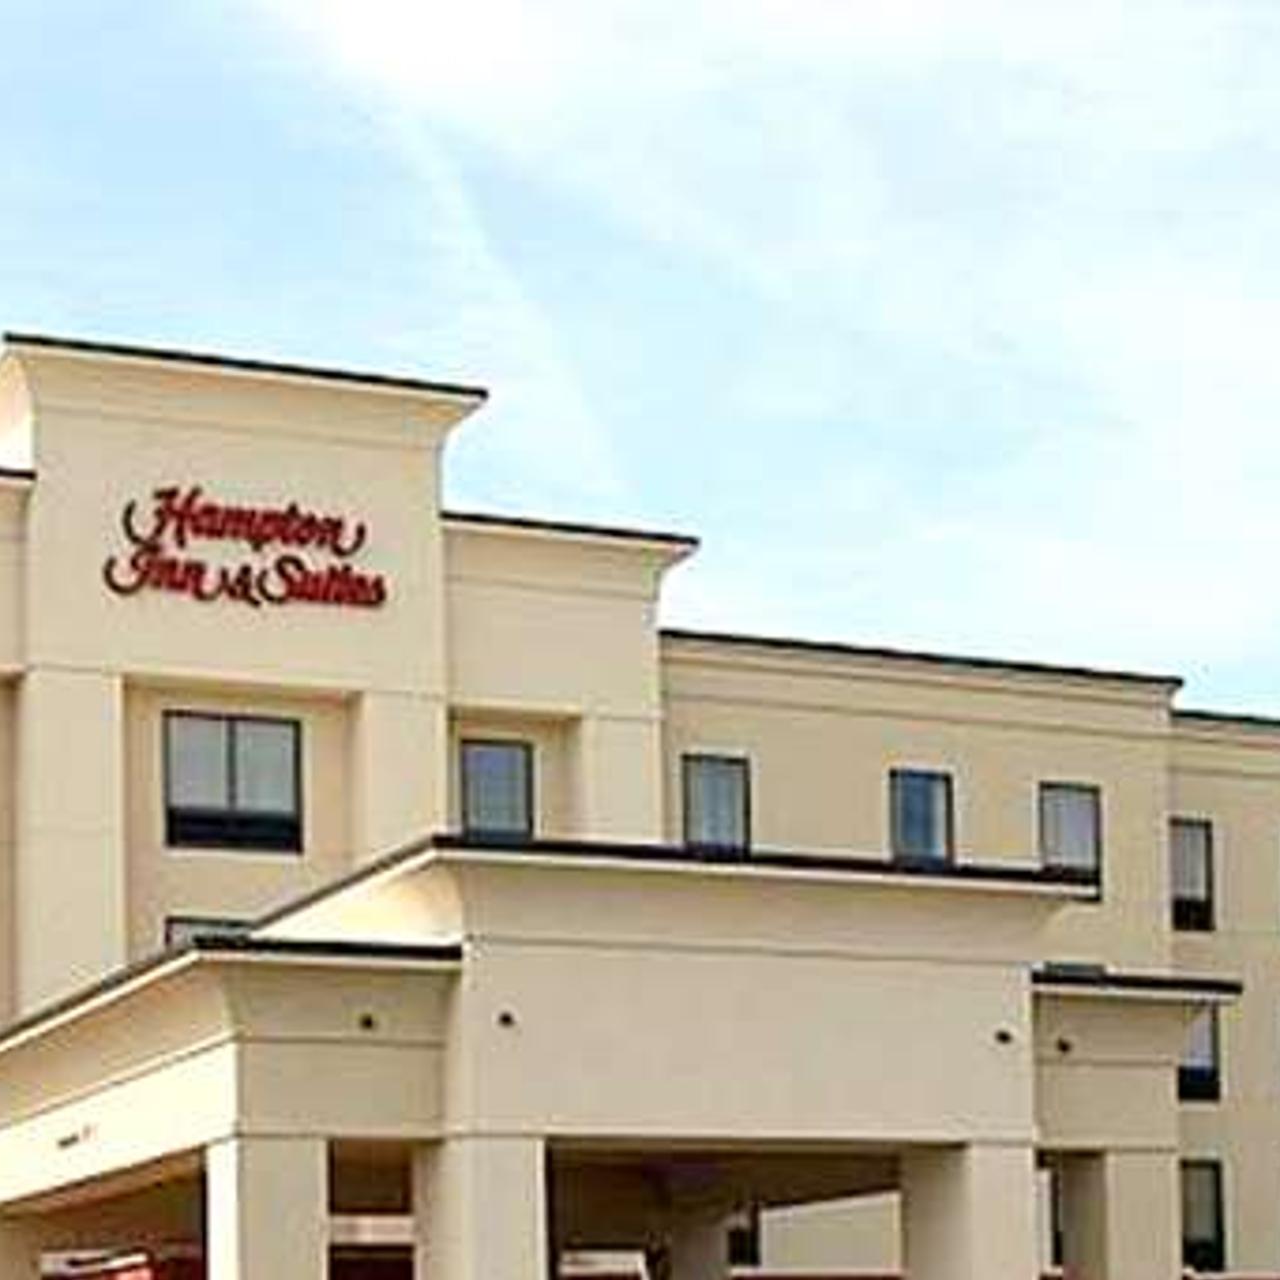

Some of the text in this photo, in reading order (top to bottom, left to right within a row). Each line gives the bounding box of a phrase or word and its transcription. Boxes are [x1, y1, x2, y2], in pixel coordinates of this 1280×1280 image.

[122, 486, 366, 556] Hampton
[103, 547, 387, 608] Inn & Suites
